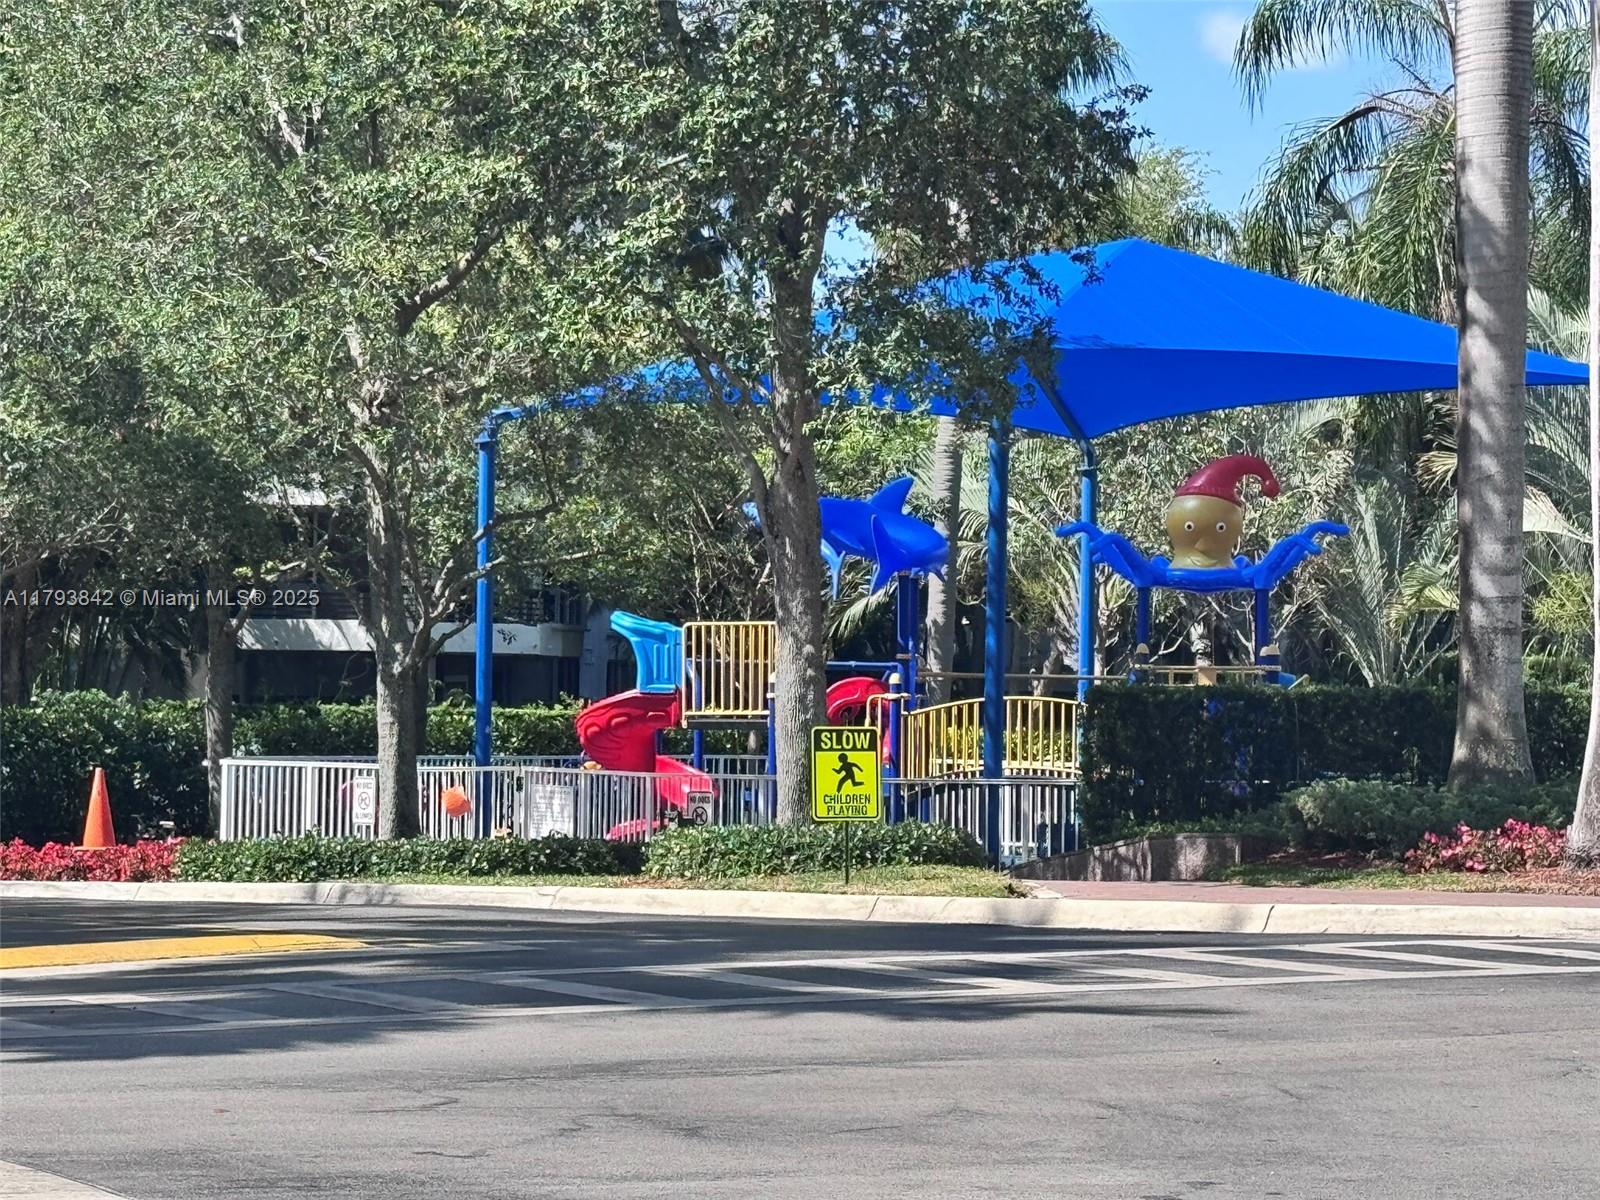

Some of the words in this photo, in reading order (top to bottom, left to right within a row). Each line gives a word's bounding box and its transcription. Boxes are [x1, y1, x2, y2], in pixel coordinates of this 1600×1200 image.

[820, 731, 870, 749] SLOW
[823, 794, 870, 804] CHILDREN
[827, 805, 867, 815] PLAYING
